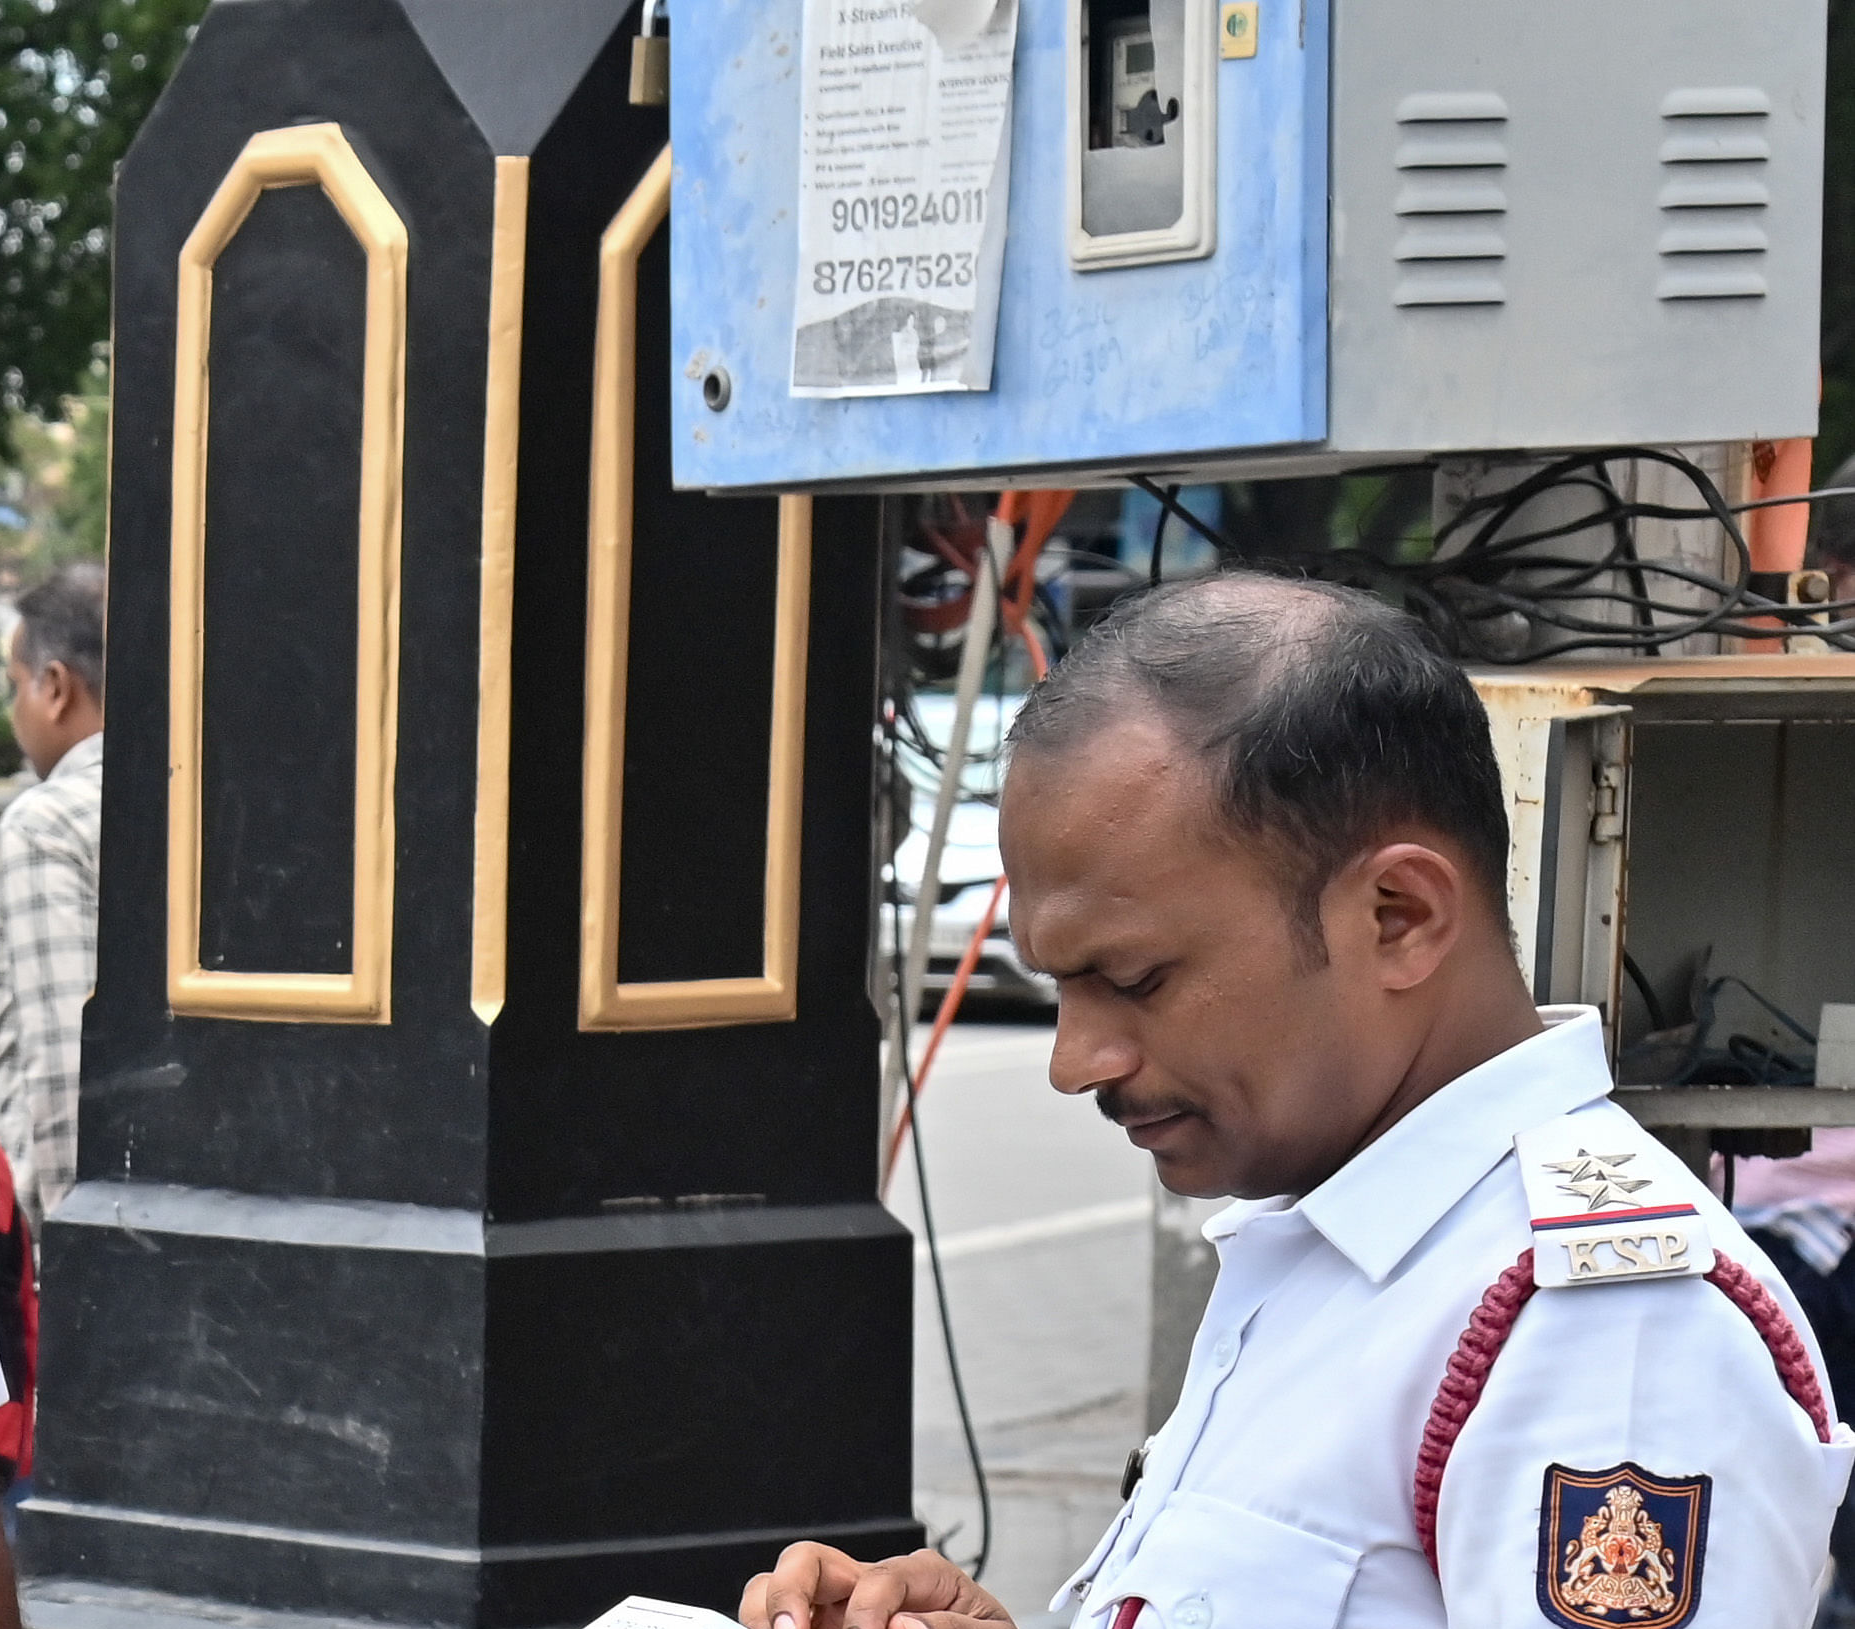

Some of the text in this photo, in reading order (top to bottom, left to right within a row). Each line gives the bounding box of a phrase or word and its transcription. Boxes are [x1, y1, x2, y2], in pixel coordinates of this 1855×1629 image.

[832, 187, 988, 233] 901924011
[812, 252, 979, 295] 87627523
[1560, 1231, 1691, 1281] KSP
